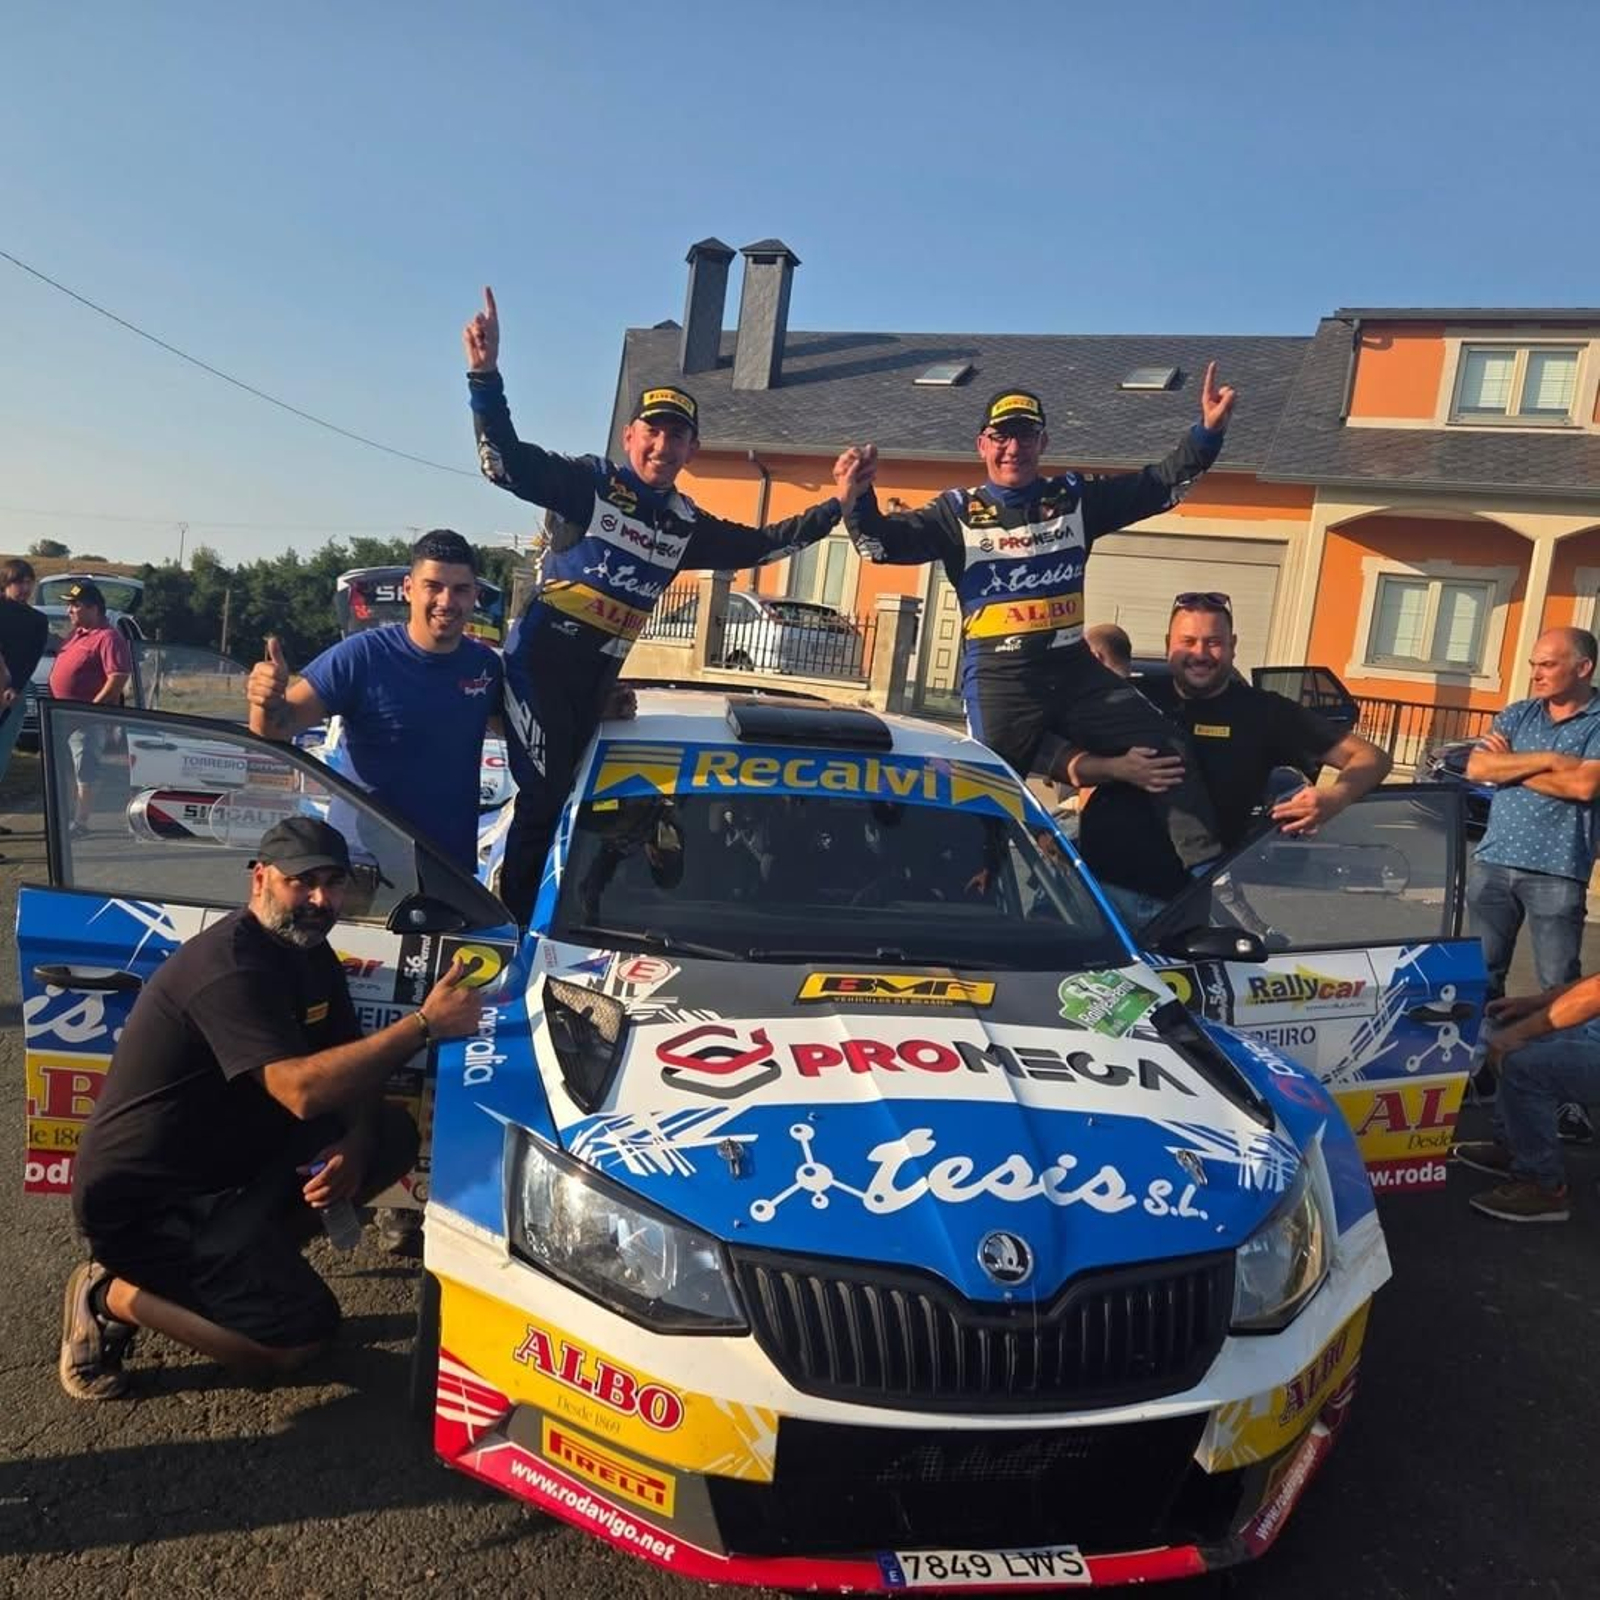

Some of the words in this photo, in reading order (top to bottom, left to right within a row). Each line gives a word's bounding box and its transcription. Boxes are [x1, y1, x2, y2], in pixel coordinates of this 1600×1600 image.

[998, 526, 1075, 550] PROMEGA
[1004, 600, 1077, 624] ALBO
[691, 750, 940, 799] Recalvi
[625, 960, 662, 979] E
[1248, 973, 1367, 1001] Rallycar
[790, 1039, 1199, 1097] PROMEGA
[863, 1128, 1137, 1215] tesis
[1143, 1179, 1209, 1219] S.L.
[514, 1325, 685, 1432] ALBO
[549, 1430, 667, 1507] PIRELLI
[510, 1456, 676, 1562] www.rodavigo.net
[902, 1554, 993, 1581] 7849
[1000, 1550, 1084, 1578] LWS
